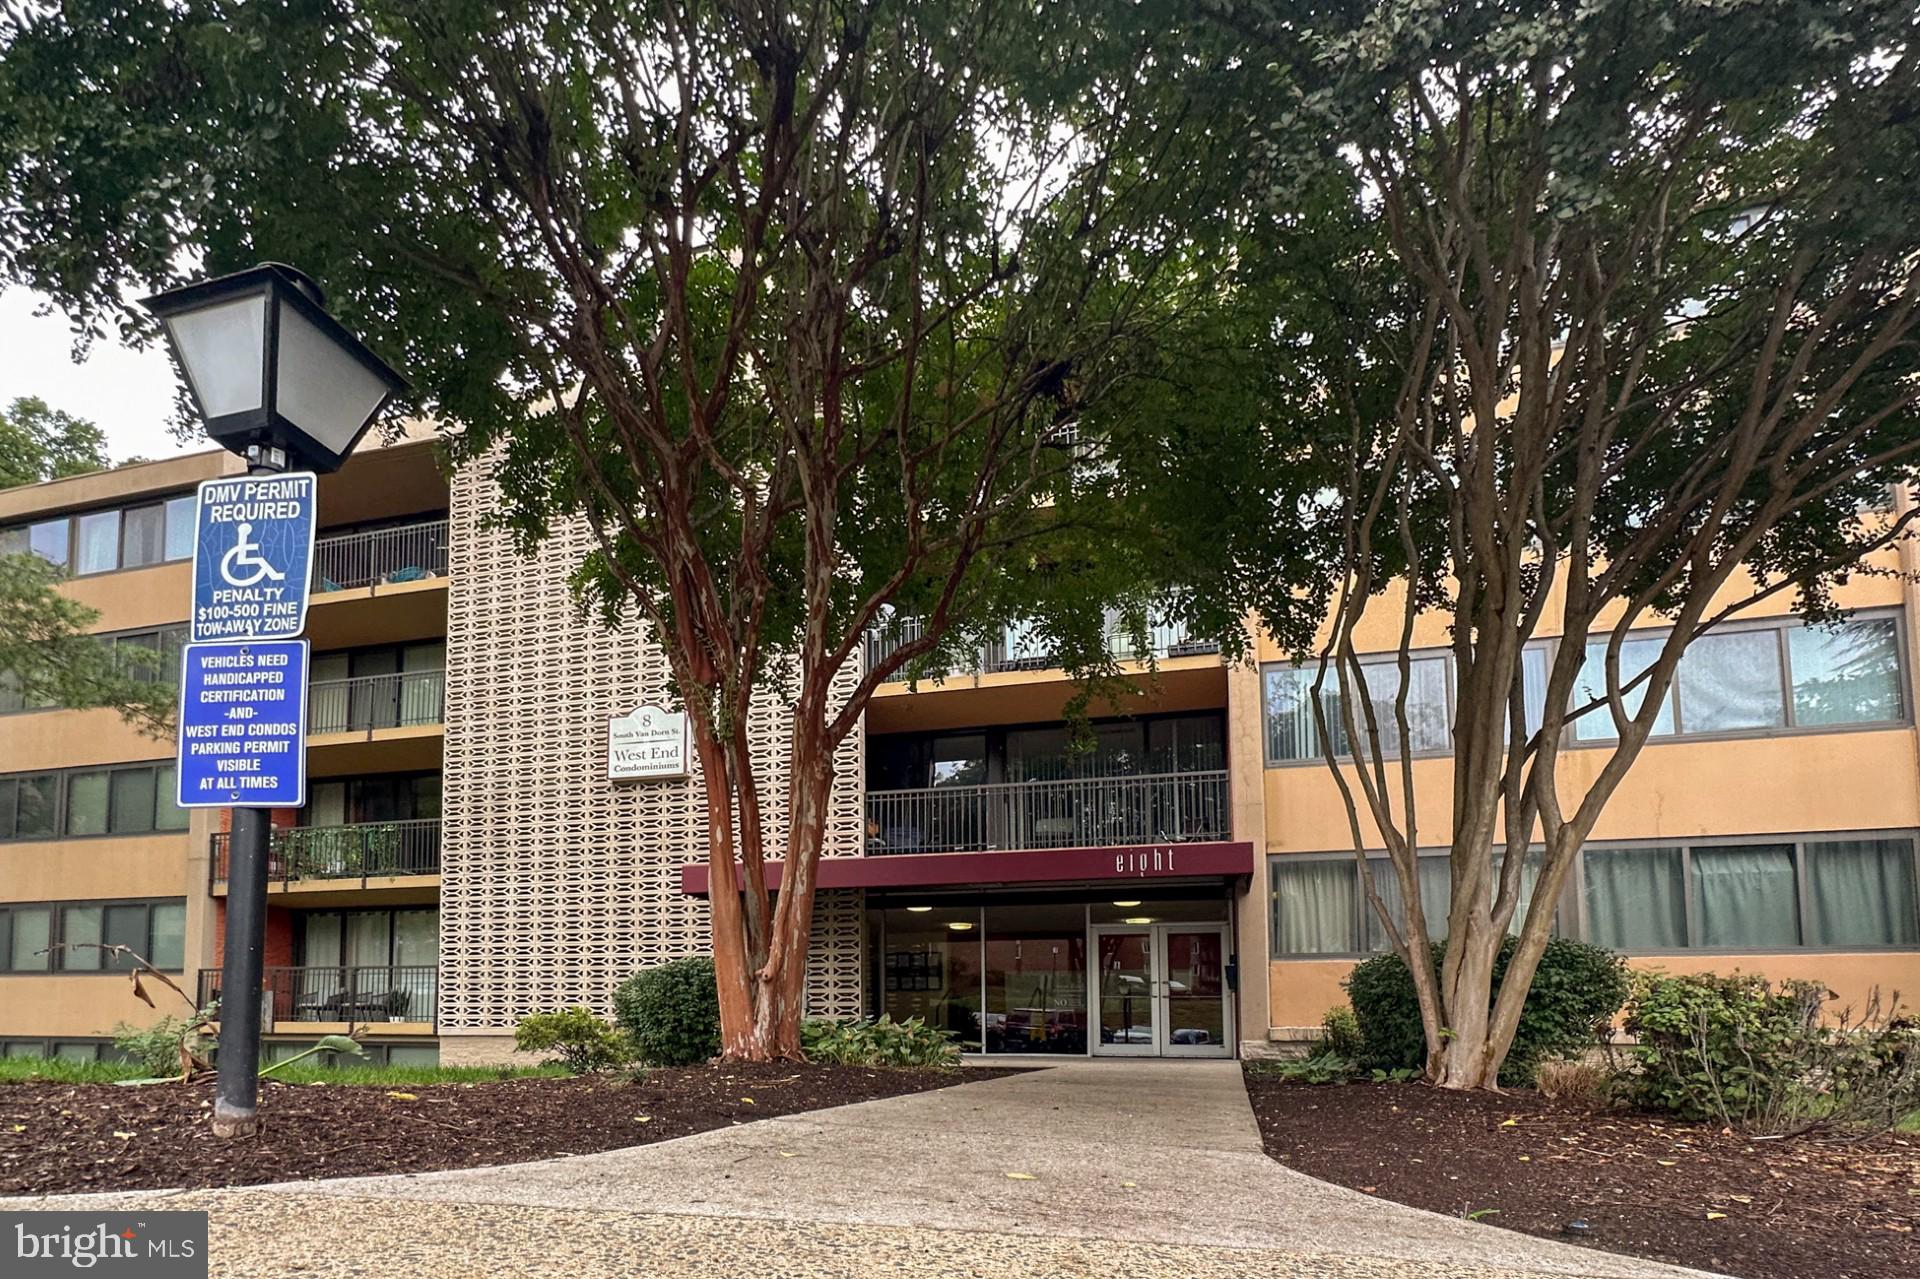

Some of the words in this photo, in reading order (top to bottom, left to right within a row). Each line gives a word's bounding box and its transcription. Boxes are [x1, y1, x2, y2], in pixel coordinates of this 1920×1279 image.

[204, 484, 242, 505] DMV
[244, 479, 310, 501] PERMIT
[210, 501, 301, 523] REQUIRED
[213, 587, 285, 604] PENALTY
[198, 604, 259, 621] $100-500
[263, 602, 298, 616] FINE
[196, 619, 263, 636] TOW-AWAY
[264, 617, 298, 632] ZONE
[201, 655, 254, 669] VEHICLES
[257, 654, 288, 667] NEED
[203, 671, 284, 686] HANDICAPPED
[200, 688, 285, 703] CERTIFICATION
[223, 707, 258, 719] -AND-
[642, 714, 652, 727] 8
[186, 725, 218, 738] WEST
[221, 723, 245, 737] END
[248, 722, 297, 736] CONDOS
[613, 730, 634, 738] South
[635, 729, 649, 737] Van
[651, 728, 670, 736] Dorn
[191, 741, 241, 755] PARKING
[244, 740, 291, 753] PERMIT
[614, 749, 646, 762] West
[650, 746, 679, 759] End
[217, 758, 261, 772] VISIBLE
[613, 762, 680, 773] Condominiums
[199, 777, 214, 790] AT
[216, 777, 237, 790] ALL
[239, 776, 278, 789] TIMES
[1116, 848, 1174, 877] eight
